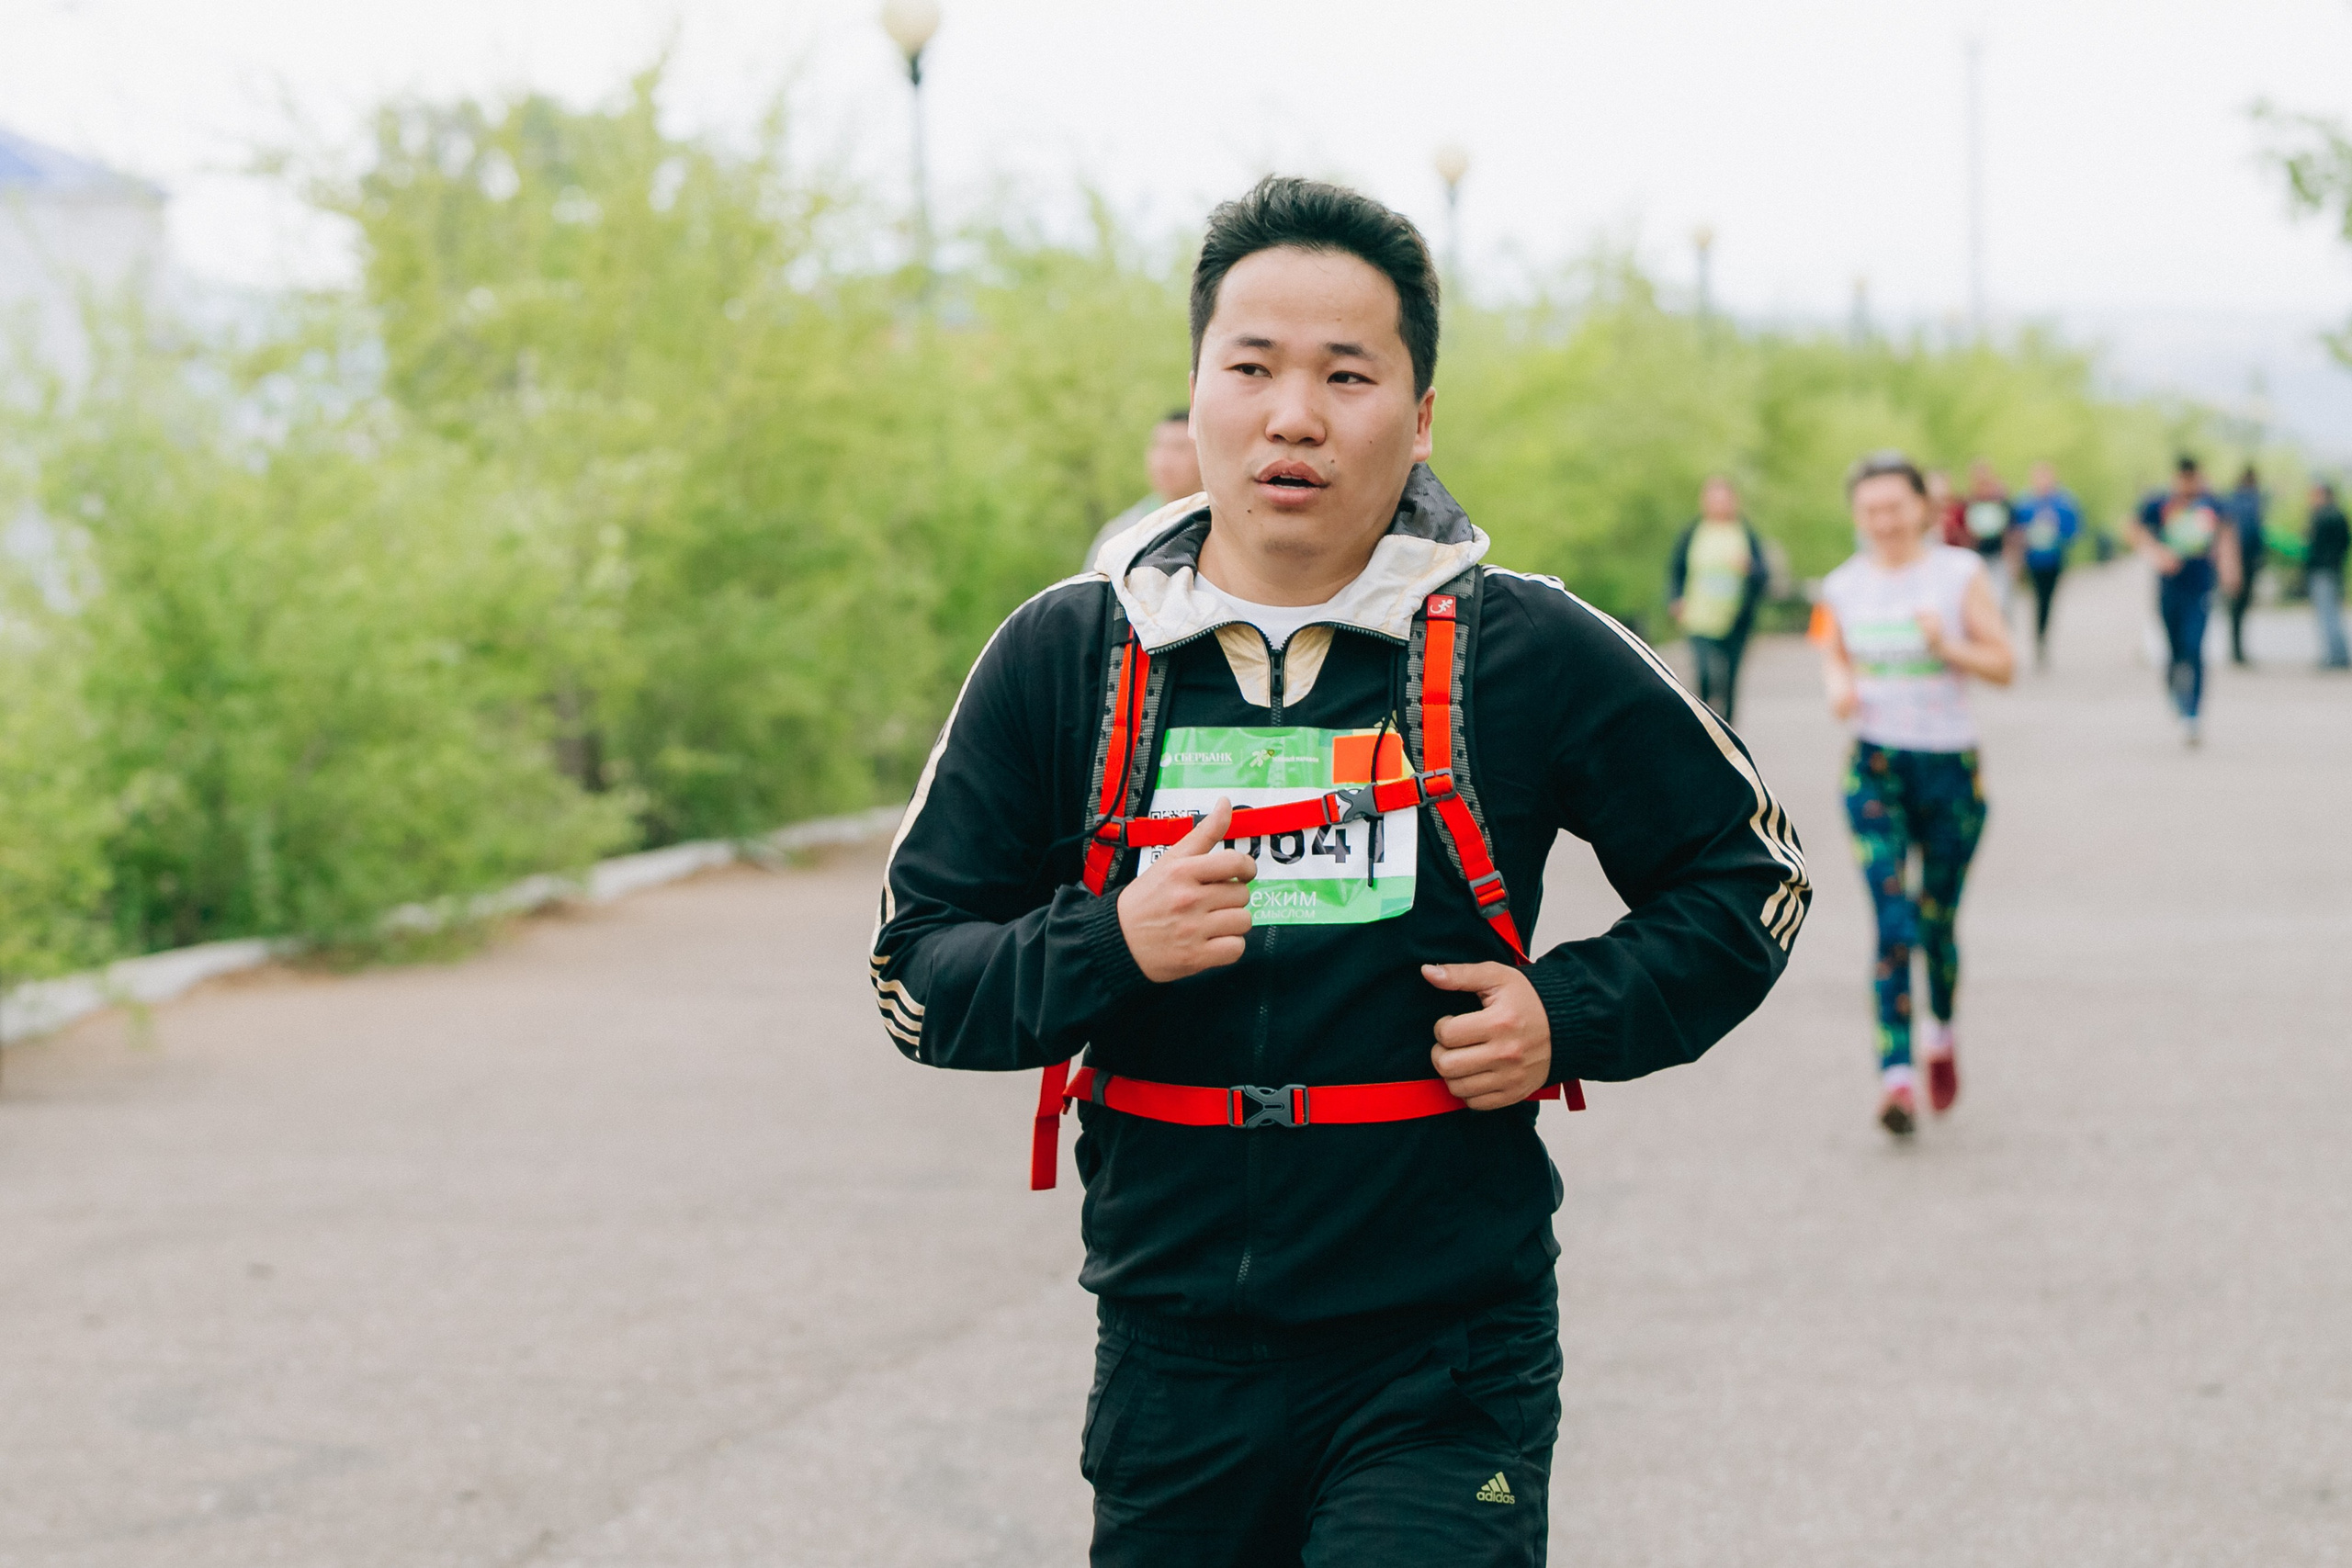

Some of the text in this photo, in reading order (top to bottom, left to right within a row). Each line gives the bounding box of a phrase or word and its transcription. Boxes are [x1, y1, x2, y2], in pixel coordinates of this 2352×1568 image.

[1174, 752, 1232, 762] СБЕРБАНК
[1250, 891, 1317, 908] ежим
[1476, 1491, 1515, 1505] adidas
